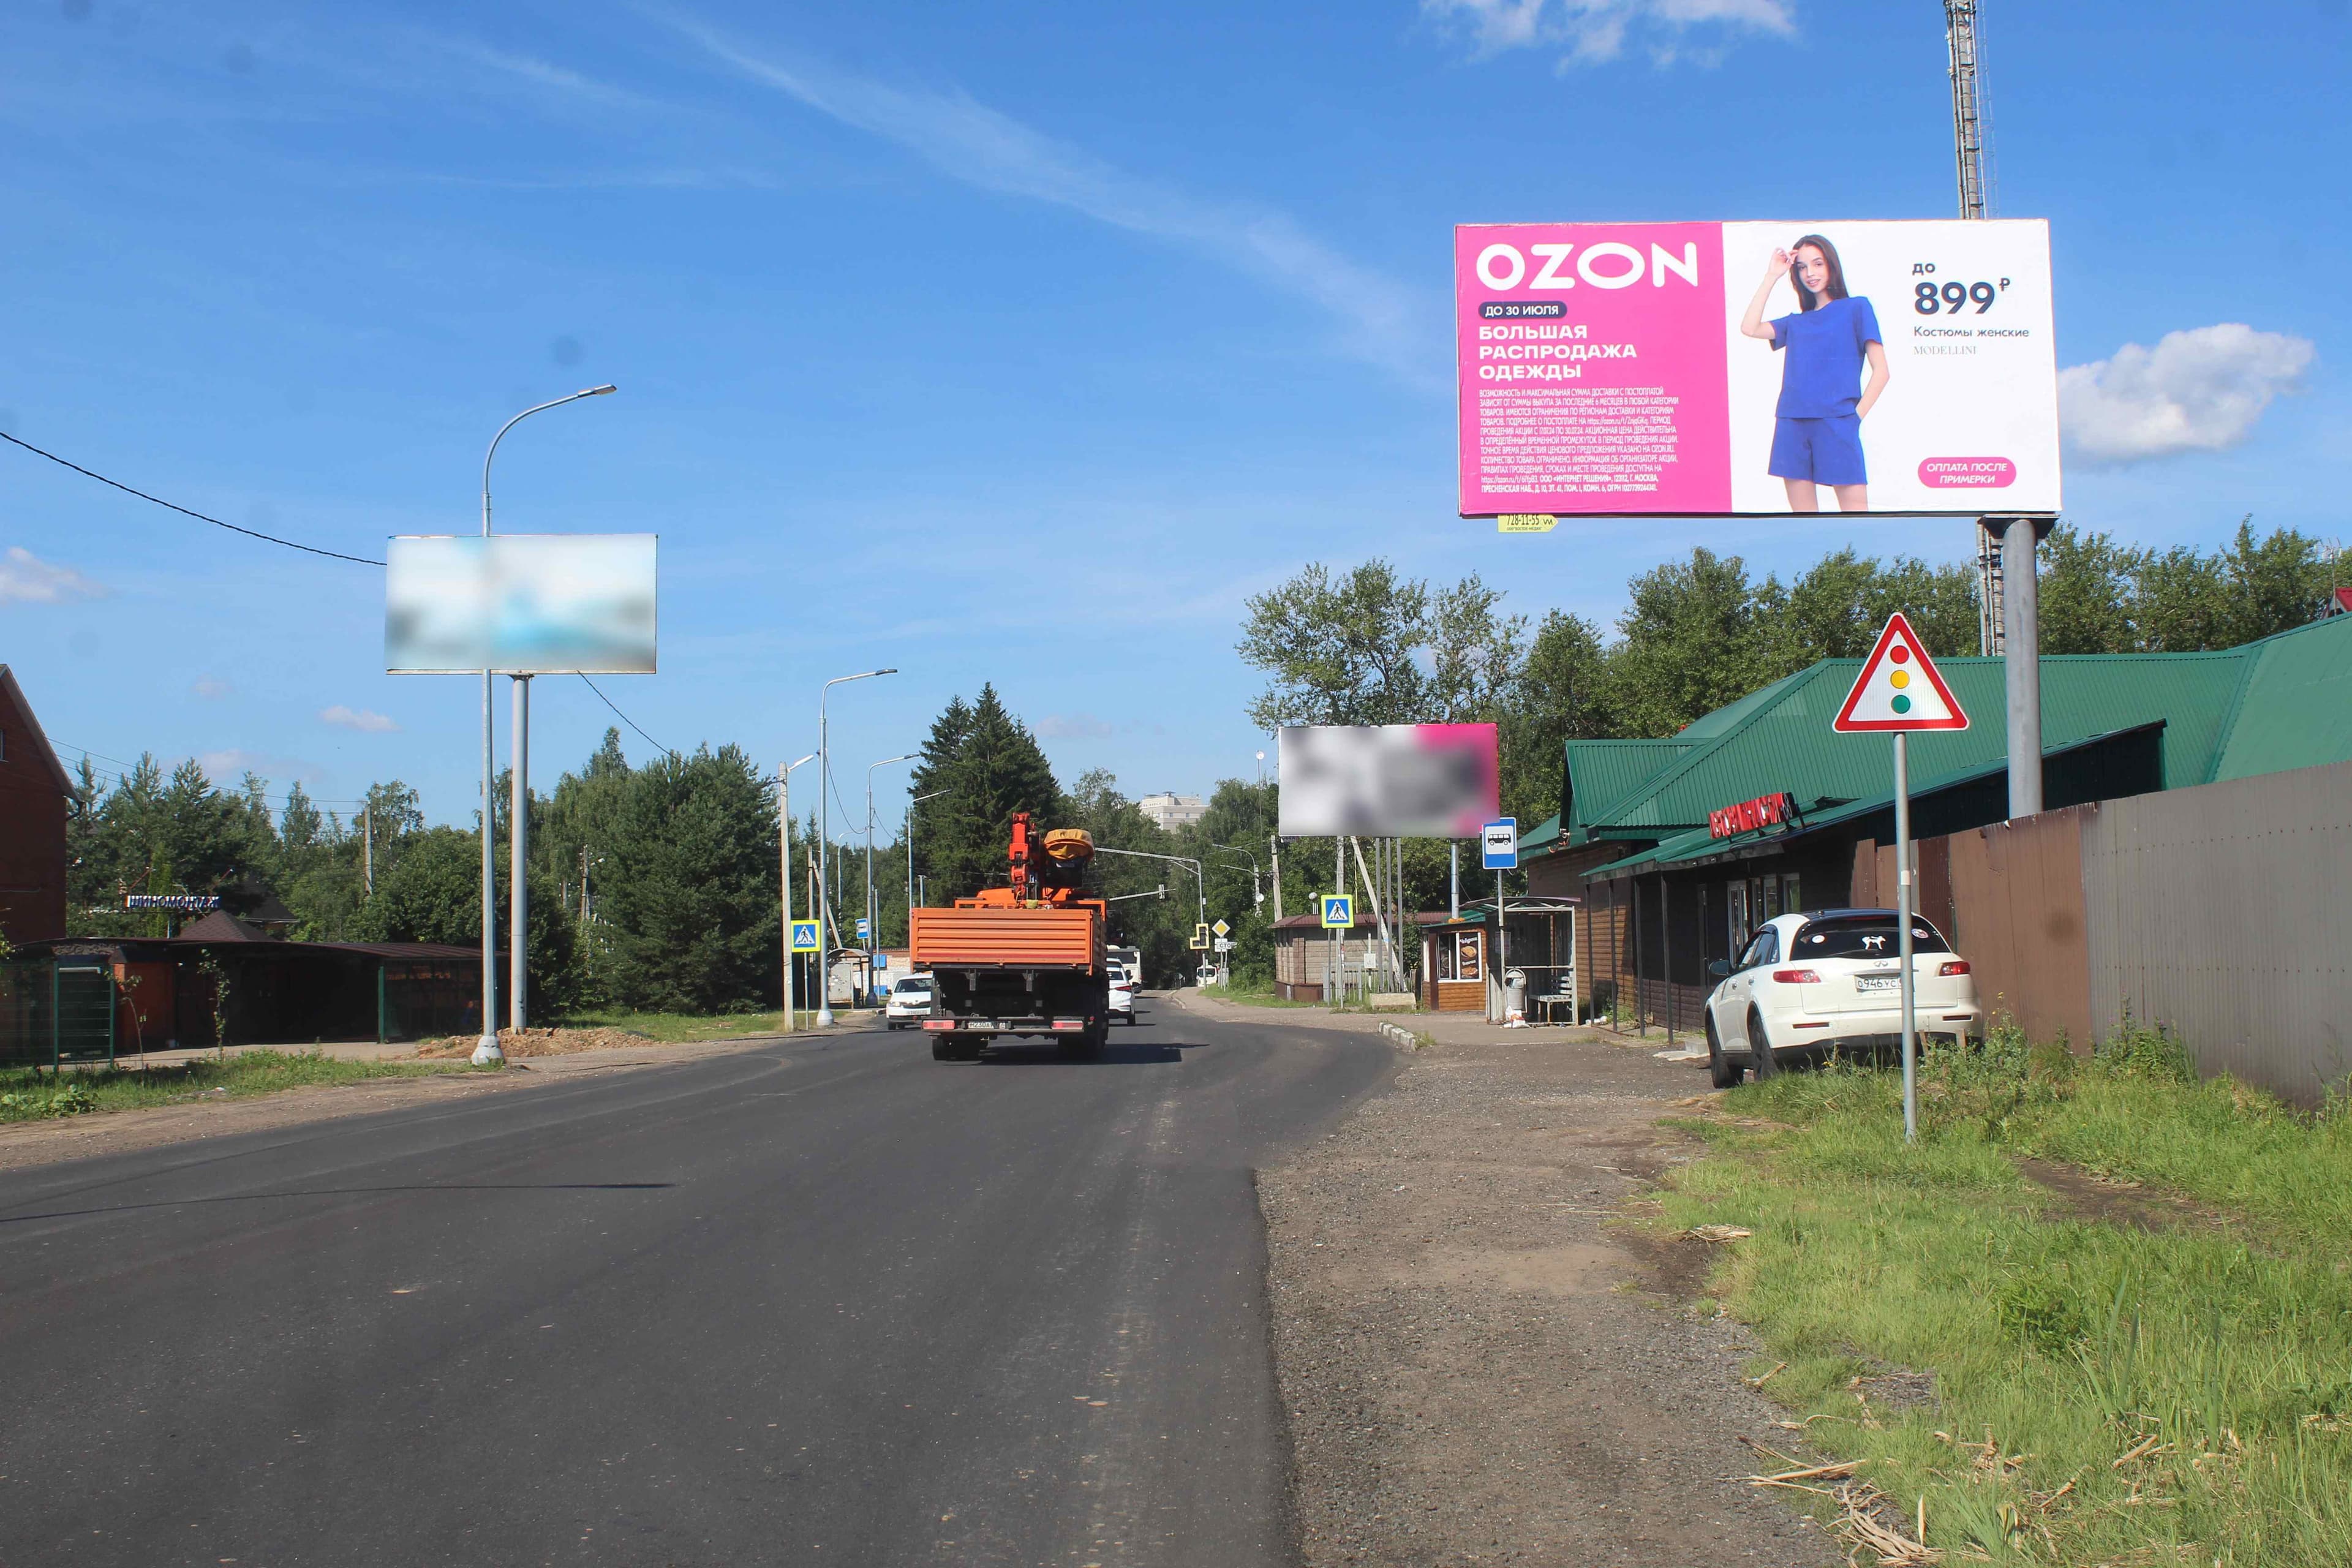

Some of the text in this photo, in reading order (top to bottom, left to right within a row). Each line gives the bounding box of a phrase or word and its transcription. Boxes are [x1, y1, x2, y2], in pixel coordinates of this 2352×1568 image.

[1476, 242, 1698, 291] OZON
[1485, 305, 1559, 317] ДО 30 ИЮЛЯ
[1479, 325, 1588, 341] БОЛЬШАЯ
[1914, 326, 2029, 339] Костюмы женские
[1479, 344, 1637, 361] РАСПРОДАЖА
[1914, 345, 1977, 355] MODELLINI
[1479, 364, 1581, 381] ОДЕЖДЫ
[1591, 388, 1619, 396] ДОСТАВКИ
[1624, 387, 1664, 396] ПОСТОПЛАТОЙ
[1600, 398, 1623, 406] МЕСЯЦЕВ
[1520, 446, 1547, 454] ДЕЙСТВИЯ
[1547, 446, 1576, 454] ЦЕНОВОГО
[1572, 455, 1610, 464] ИНФОРМАЦИЯ
[1926, 462, 2008, 472] ОПЛАТА ПОСЛЕ
[1940, 475, 1996, 484] ПРИМЕРКИ
[1507, 514, 1539, 526] 728-11-55
[129, 895, 220, 908] ШИНОМОНТАЖ
